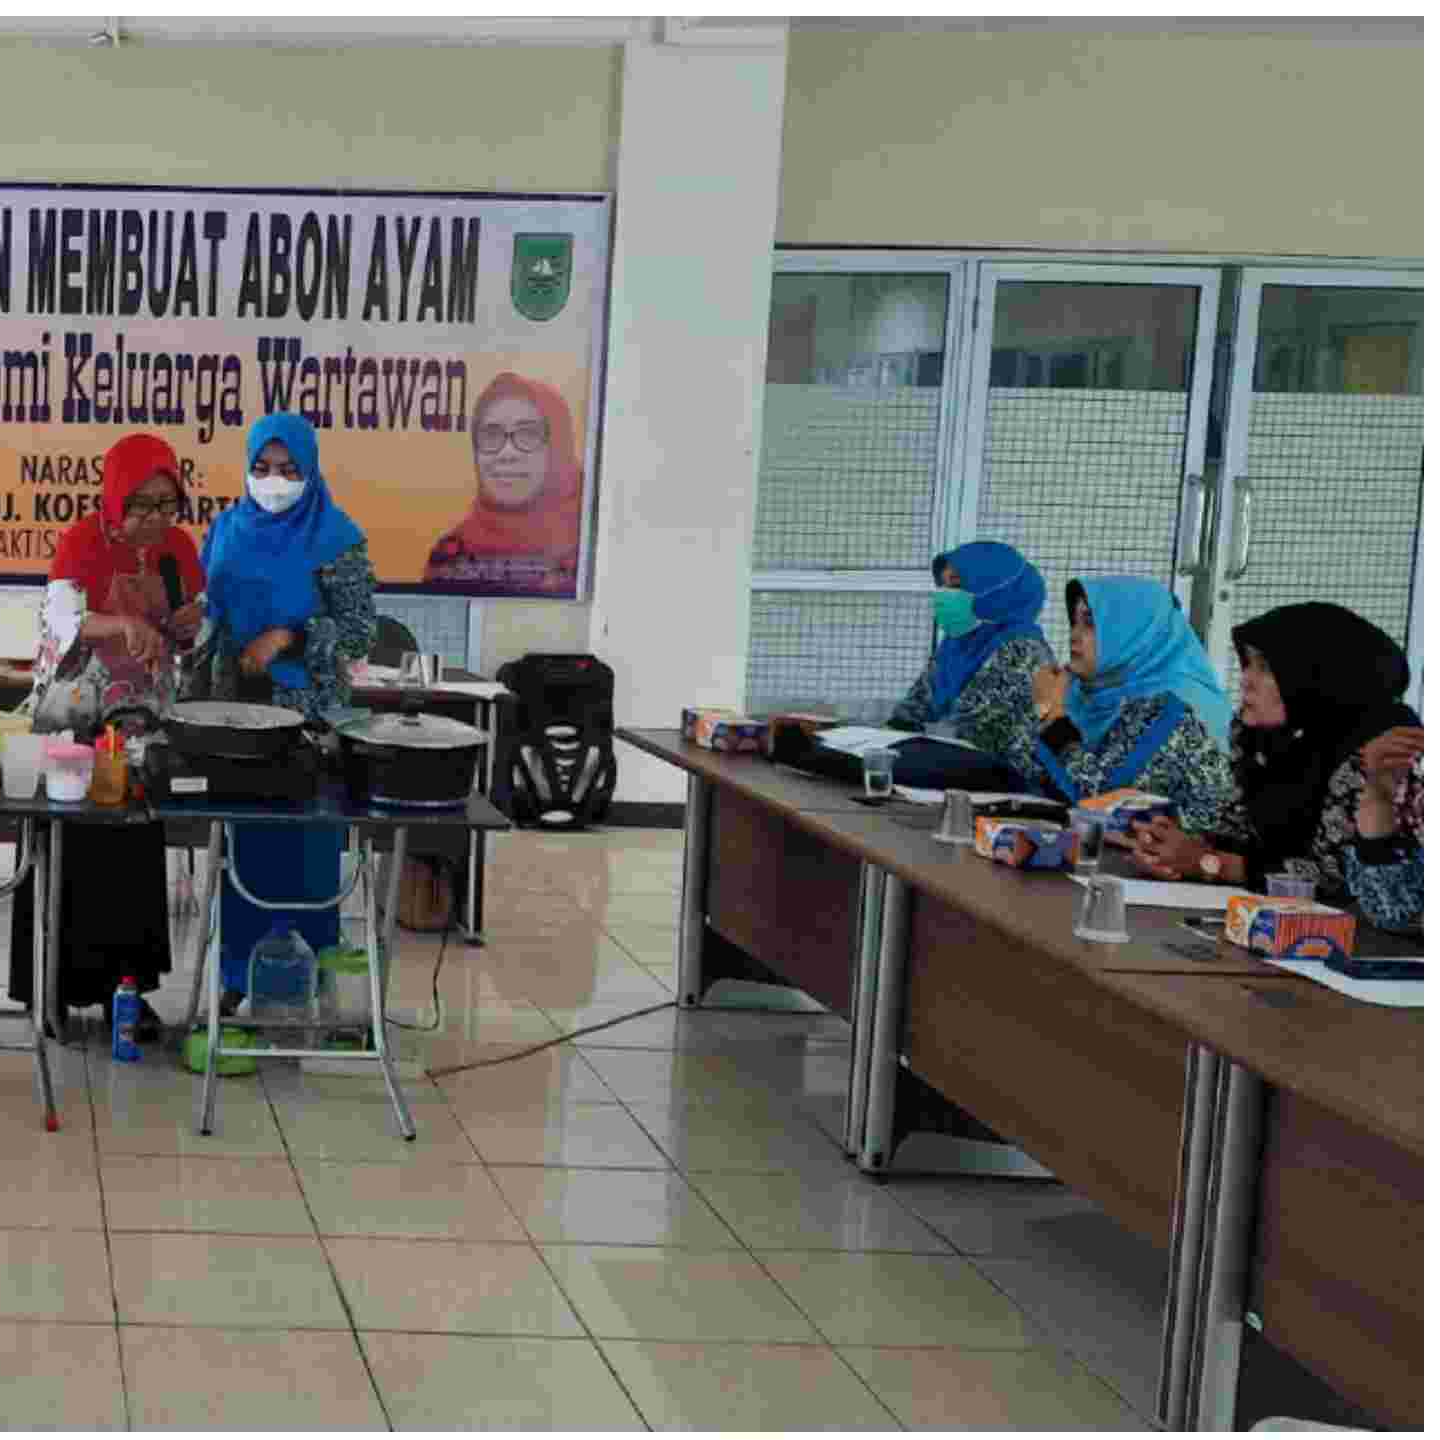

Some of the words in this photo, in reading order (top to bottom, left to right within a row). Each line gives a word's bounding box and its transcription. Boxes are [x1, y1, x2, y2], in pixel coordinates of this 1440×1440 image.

[27, 207, 228, 318] MEMBUAT
[237, 211, 353, 321] ABON
[362, 214, 481, 323] AYAM
[63, 333, 243, 444] Keluarga
[257, 337, 467, 432] Wartawan
